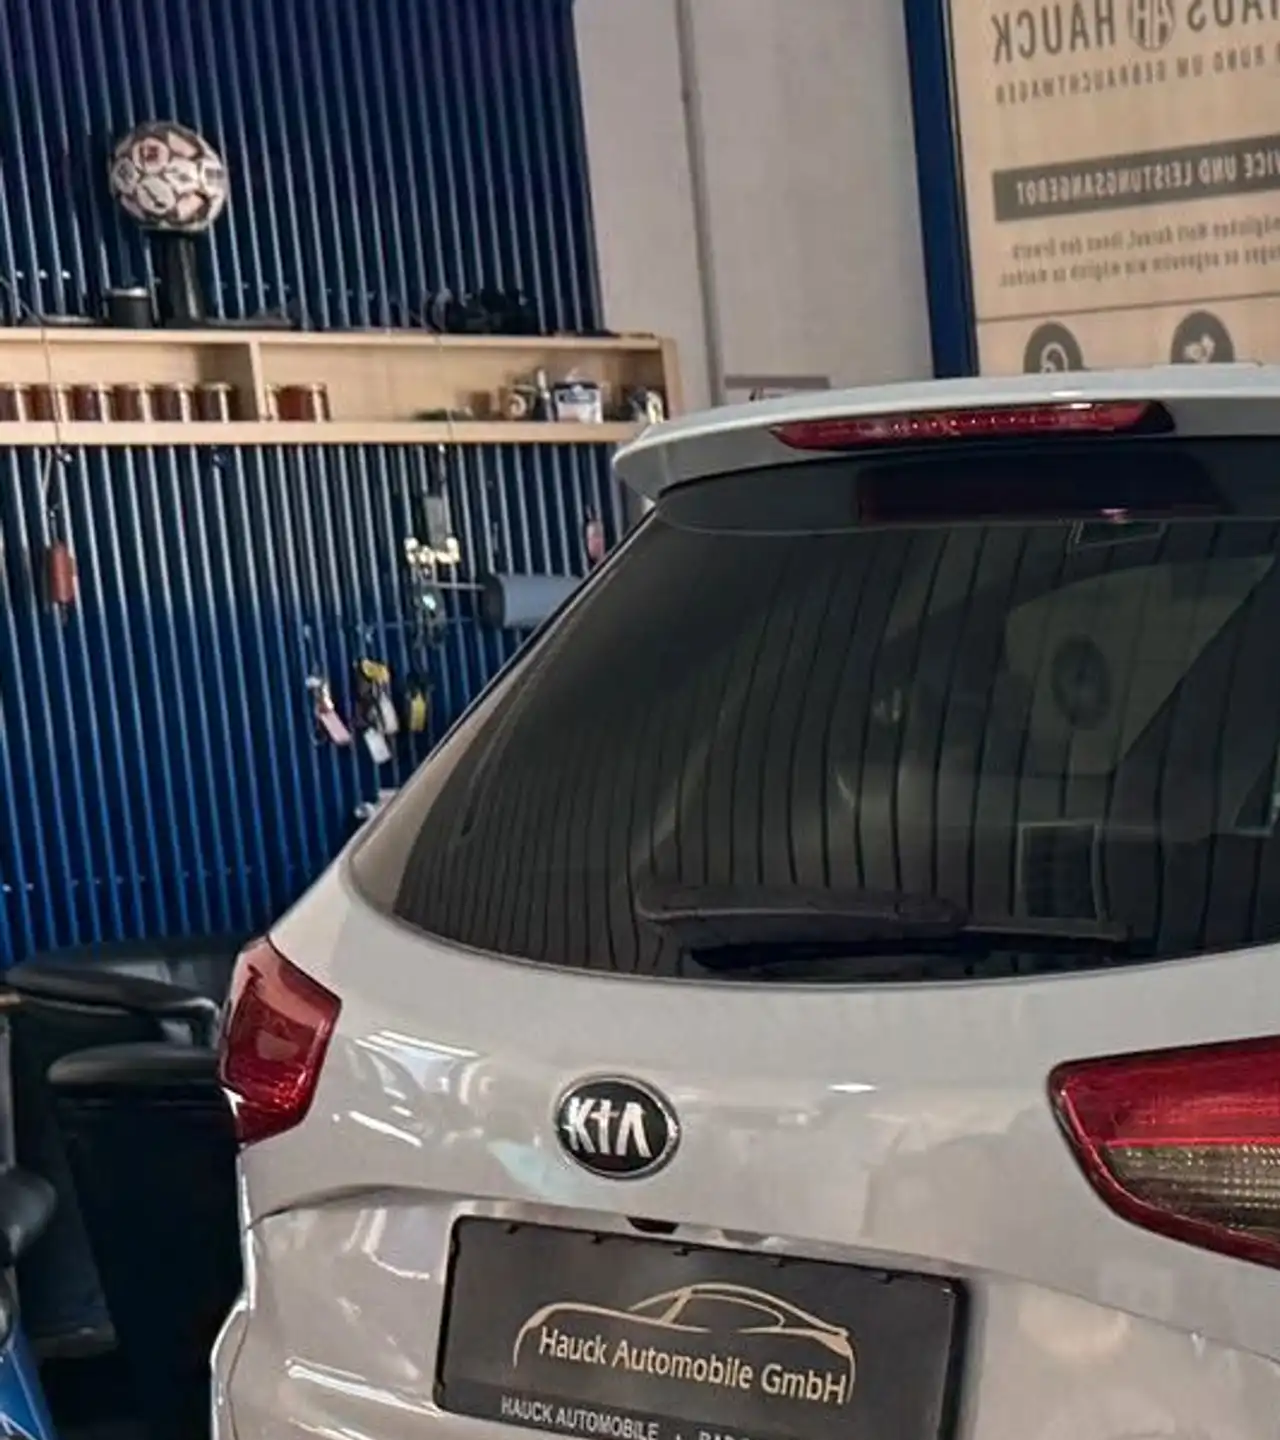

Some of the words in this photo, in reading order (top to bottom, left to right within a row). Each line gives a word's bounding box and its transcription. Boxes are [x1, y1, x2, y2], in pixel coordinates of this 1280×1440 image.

[562, 1096, 653, 1158] KIA
[538, 1325, 608, 1366] Hauck
[612, 1338, 754, 1390] Automobile
[760, 1362, 848, 1406] GmbH
[501, 1395, 552, 1426] HAUCK
